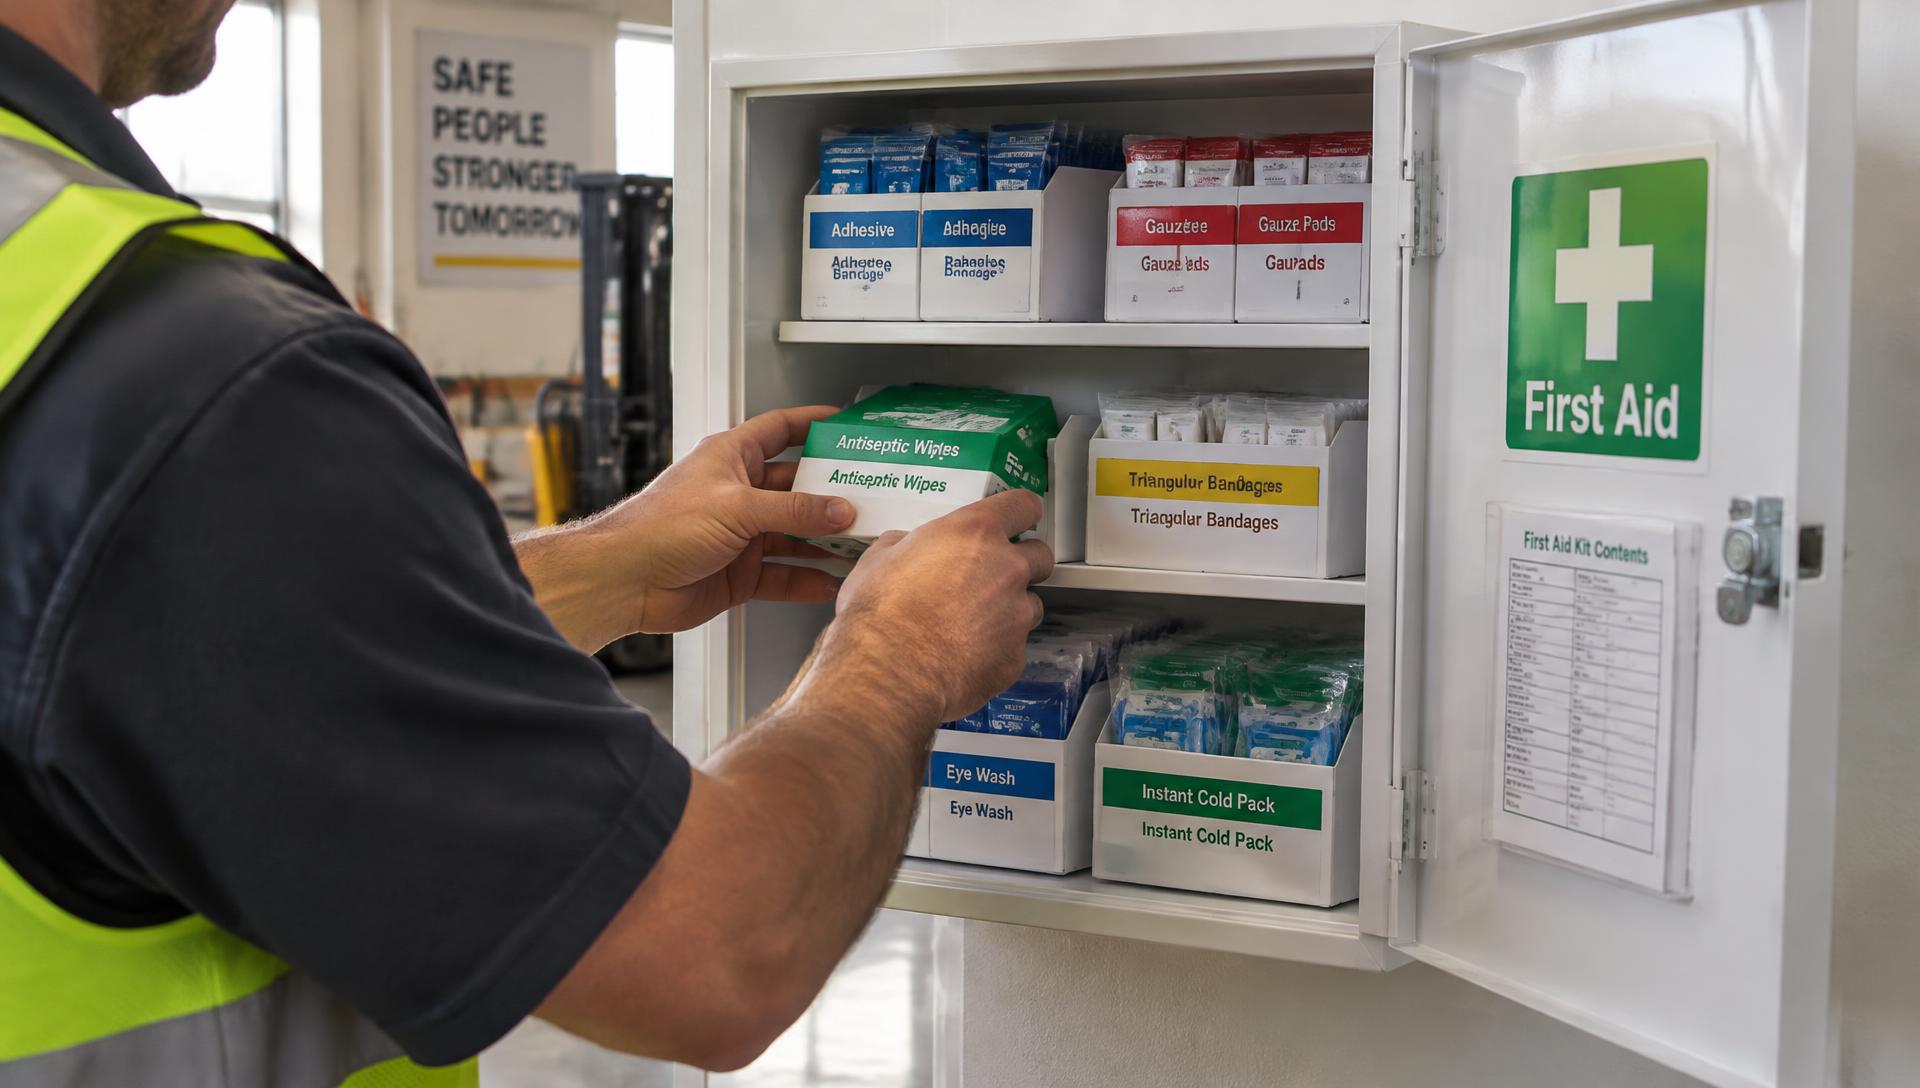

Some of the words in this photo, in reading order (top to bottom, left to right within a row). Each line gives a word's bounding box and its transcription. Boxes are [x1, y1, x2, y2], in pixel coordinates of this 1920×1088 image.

[434, 57, 513, 96] SAFE
[434, 107, 545, 146] PEOPLE
[831, 221, 895, 238] Adhesive
[1303, 215, 1336, 232] Pads
[1525, 380, 1605, 436] First
[1614, 383, 1680, 440] Aid
[836, 434, 910, 455] Antiseptic
[903, 474, 947, 494] Wipes
[1207, 512, 1279, 533] Bandages
[1524, 531, 1550, 552] First
[1552, 535, 1572, 554] Aid
[1574, 537, 1591, 557] Kit
[1594, 540, 1649, 565] Contents
[946, 763, 972, 784] Eye
[975, 766, 1015, 786] Wash
[1142, 783, 1194, 804] Instant
[1197, 789, 1233, 809] Cold
[1237, 793, 1276, 814] Pack
[950, 800, 973, 818] Eye
[975, 802, 1013, 821] Wash
[1142, 821, 1193, 841] Instant
[1196, 827, 1231, 846] Cold
[1235, 831, 1274, 852] Pack
